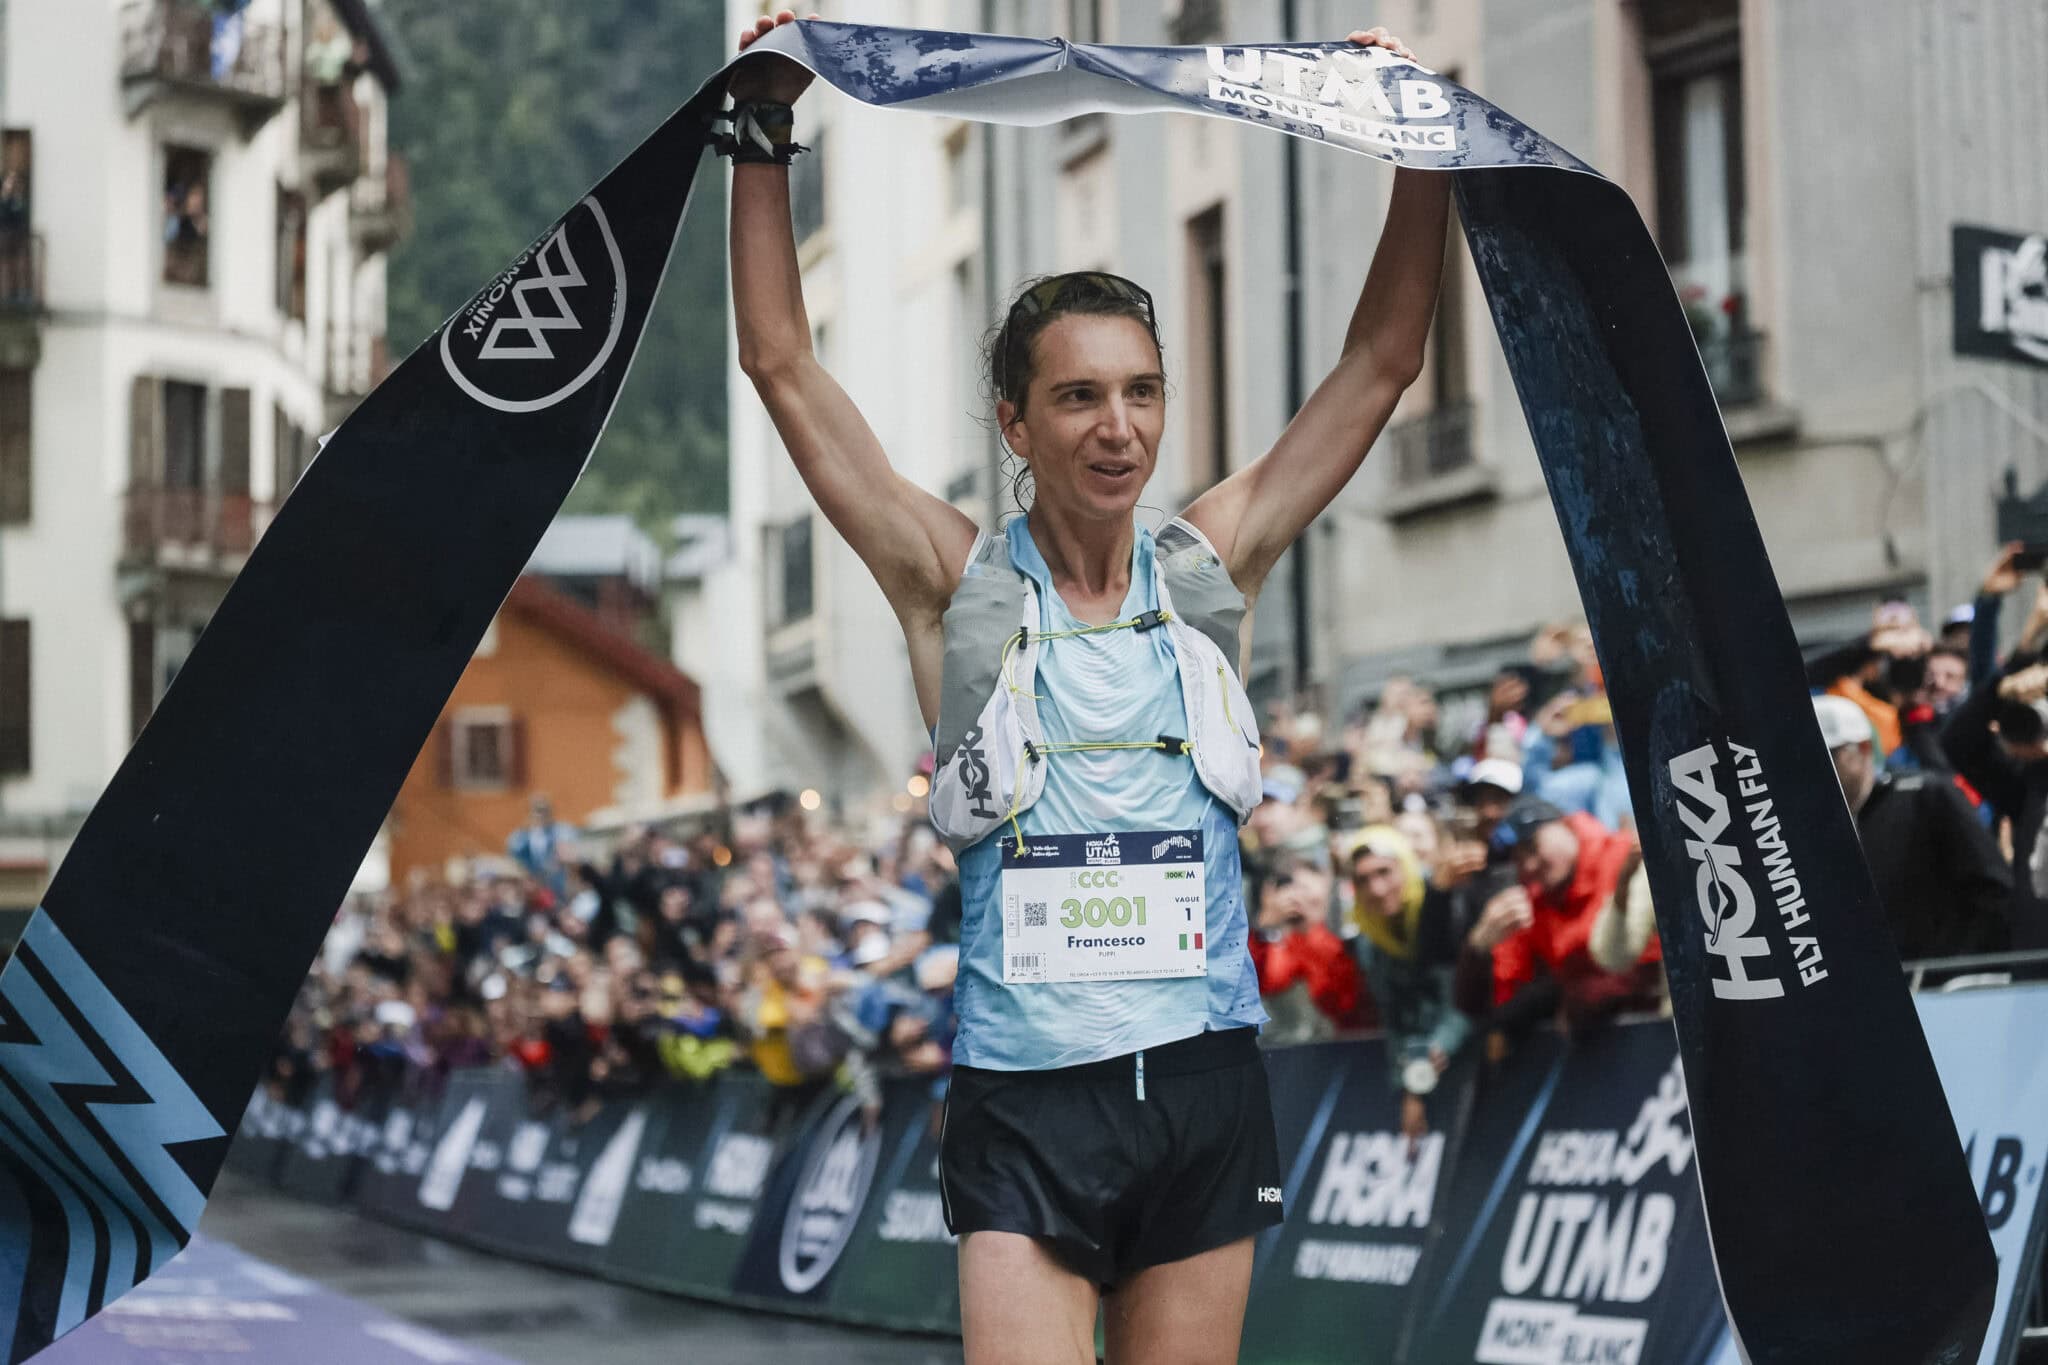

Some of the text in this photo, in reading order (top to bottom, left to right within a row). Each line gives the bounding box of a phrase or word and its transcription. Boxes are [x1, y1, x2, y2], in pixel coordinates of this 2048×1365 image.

[1205, 46, 1451, 118] UTMB
[1086, 846, 1121, 858] UTMB
[1727, 737, 1829, 988] FLY HUMAN FLY
[1078, 870, 1119, 888] CCC
[1668, 743, 1786, 1001] HOKA
[1060, 896, 1147, 929] 3001
[1185, 907, 1192, 921] 1
[1067, 935, 1146, 949] Francesco
[1500, 1192, 1677, 1304] UTMB
